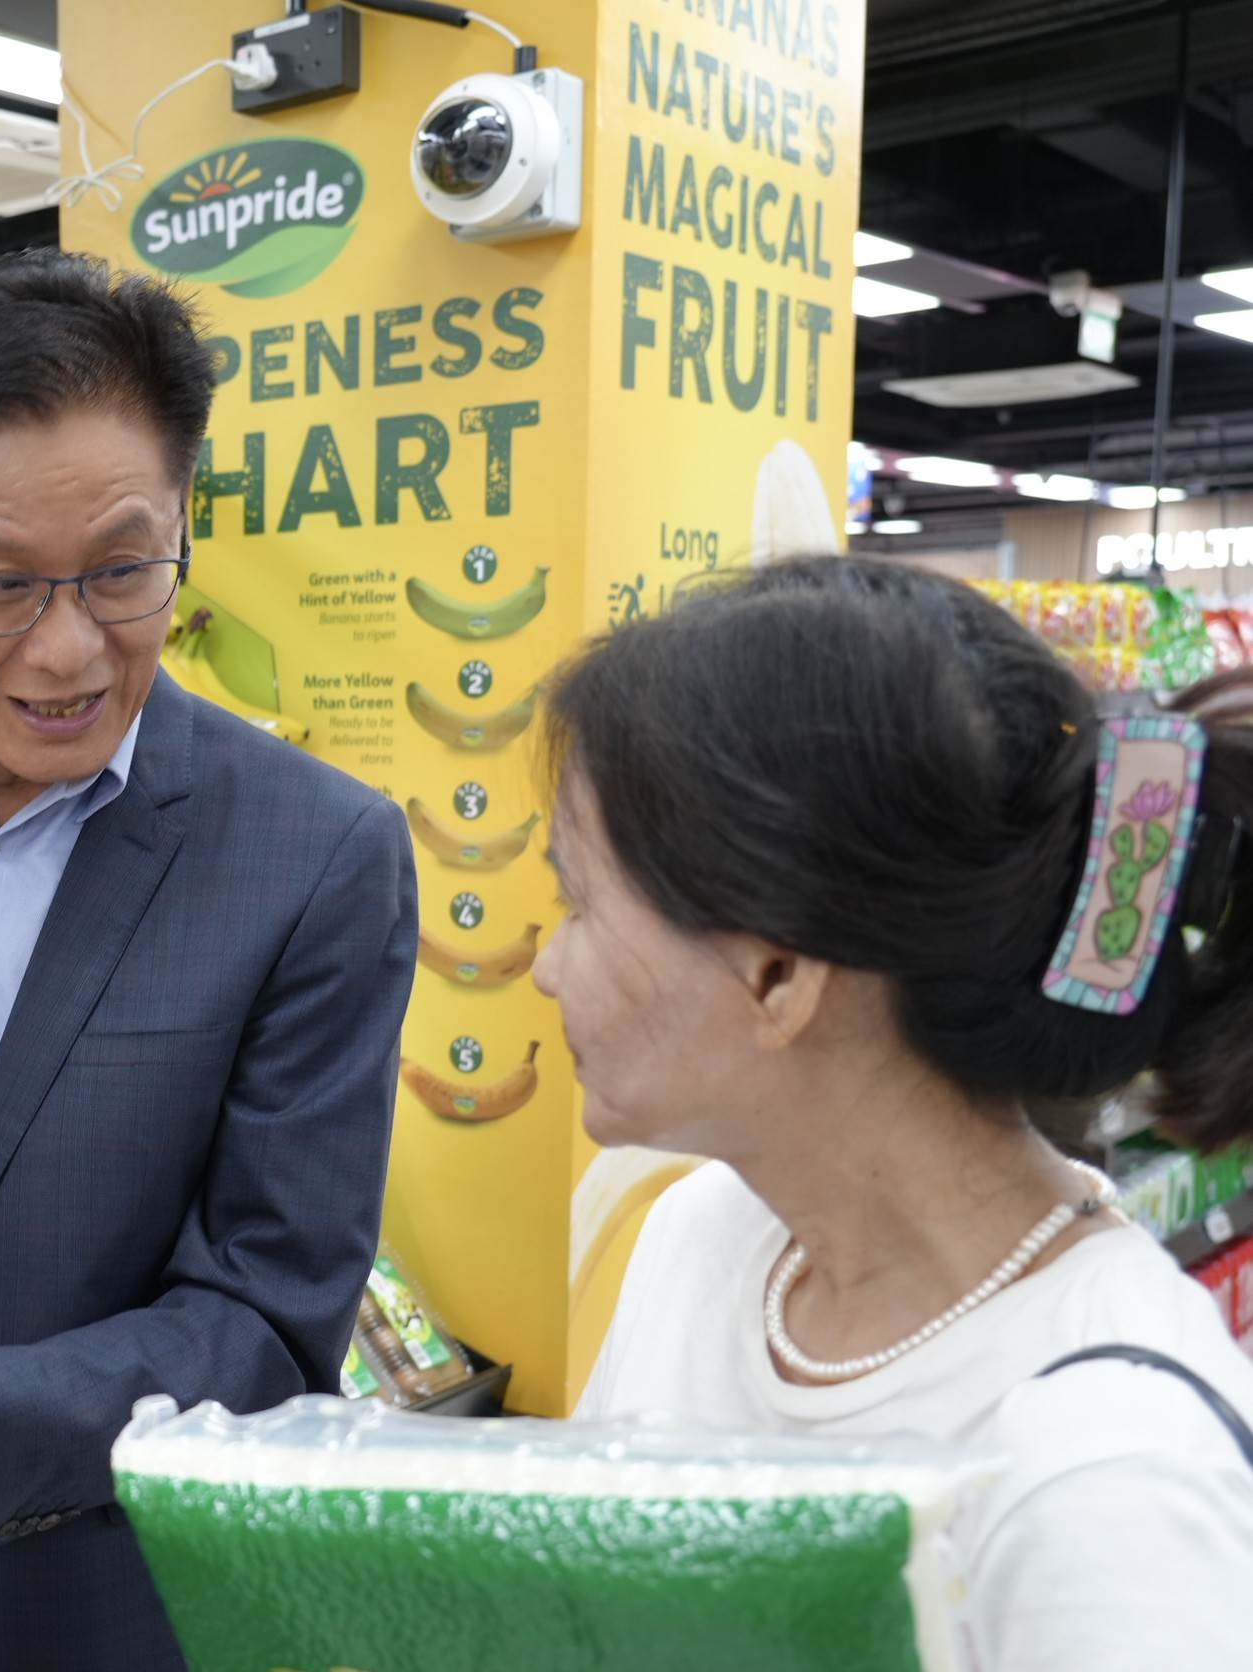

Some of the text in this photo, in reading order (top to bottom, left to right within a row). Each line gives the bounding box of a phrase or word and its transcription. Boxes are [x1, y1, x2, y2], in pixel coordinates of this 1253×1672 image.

[628, 21, 836, 177] NATURE'S
[145, 169, 345, 253] Sunpride
[623, 134, 832, 280] MAGICAL
[620, 251, 833, 423] FRUIT
[661, 521, 718, 571] Long
[309, 568, 397, 586] Green with a
[473, 559, 485, 581] 1
[299, 589, 396, 607] Hint of Yellow
[303, 671, 394, 688] More Yellow
[467, 673, 483, 695] 2
[312, 694, 393, 709] than Green
[463, 795, 479, 818] 3
[457, 905, 475, 927] 4
[458, 1049, 474, 1072] 5
